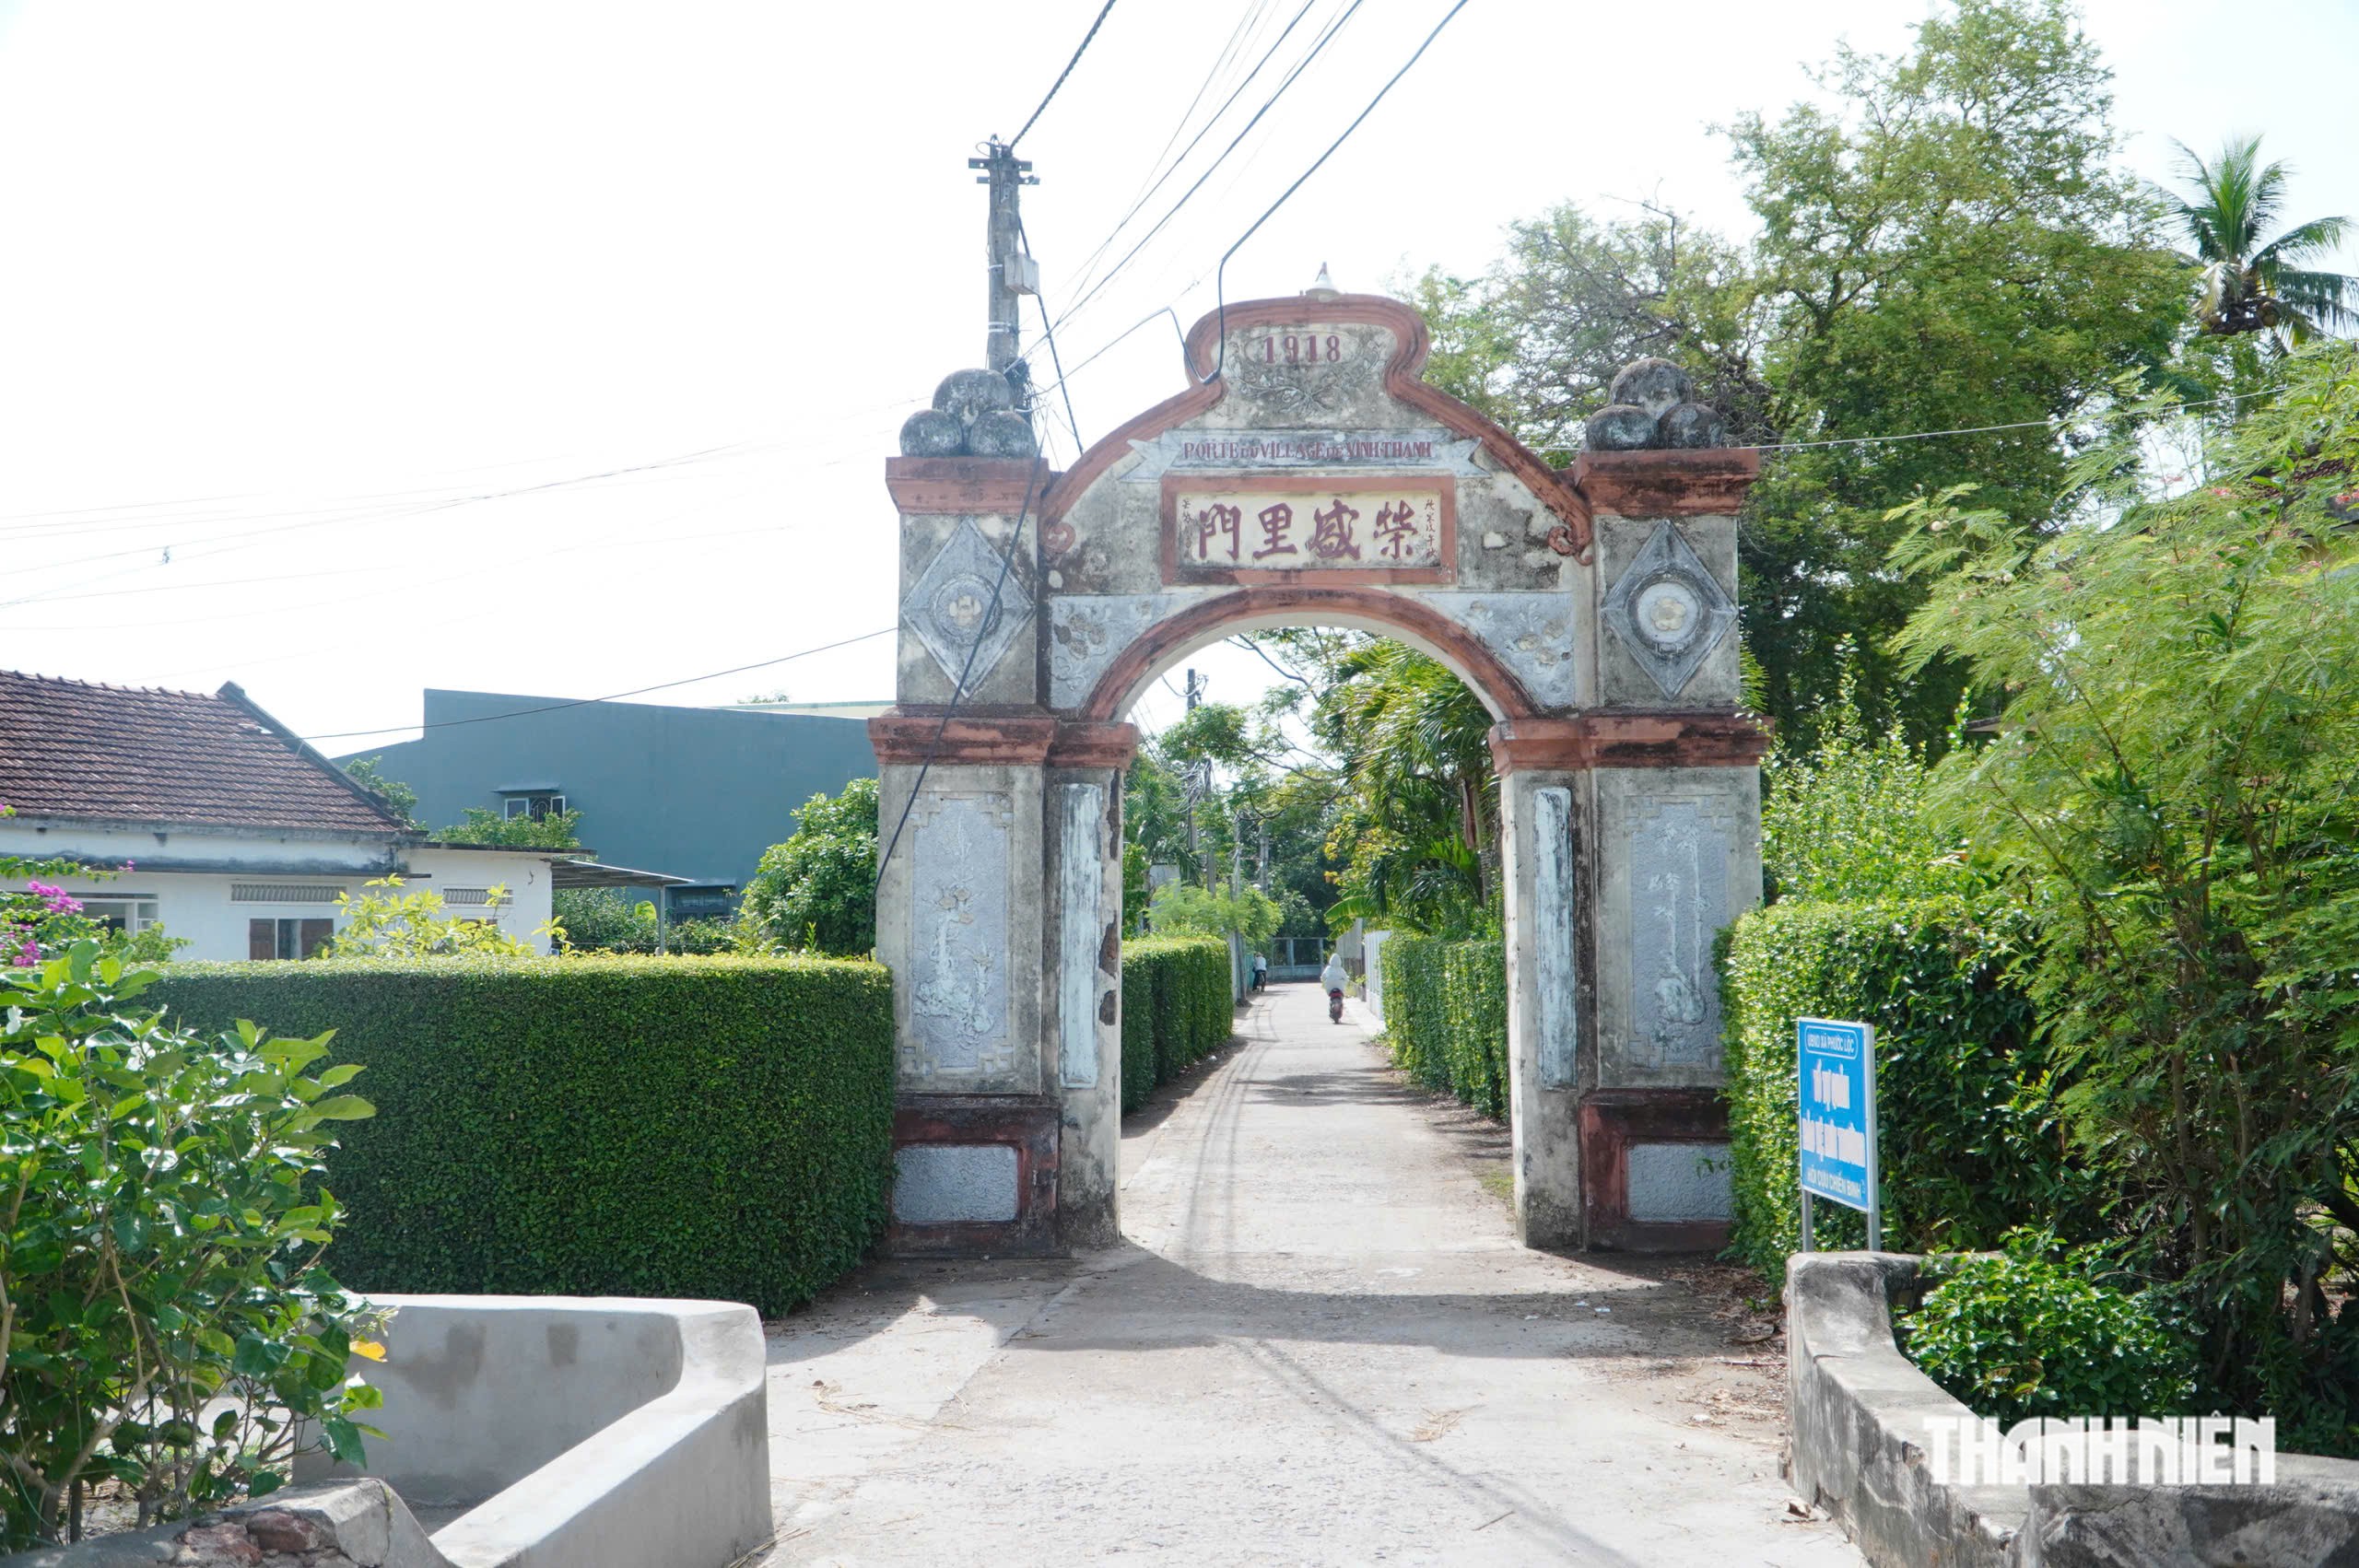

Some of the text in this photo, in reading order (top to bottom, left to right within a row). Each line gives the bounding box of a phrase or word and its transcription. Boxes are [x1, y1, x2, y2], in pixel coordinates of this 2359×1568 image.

[1262, 335, 1341, 364] 1918
[1184, 442, 1239, 459] PORTE
[1261, 440, 1325, 459] VILLAGE
